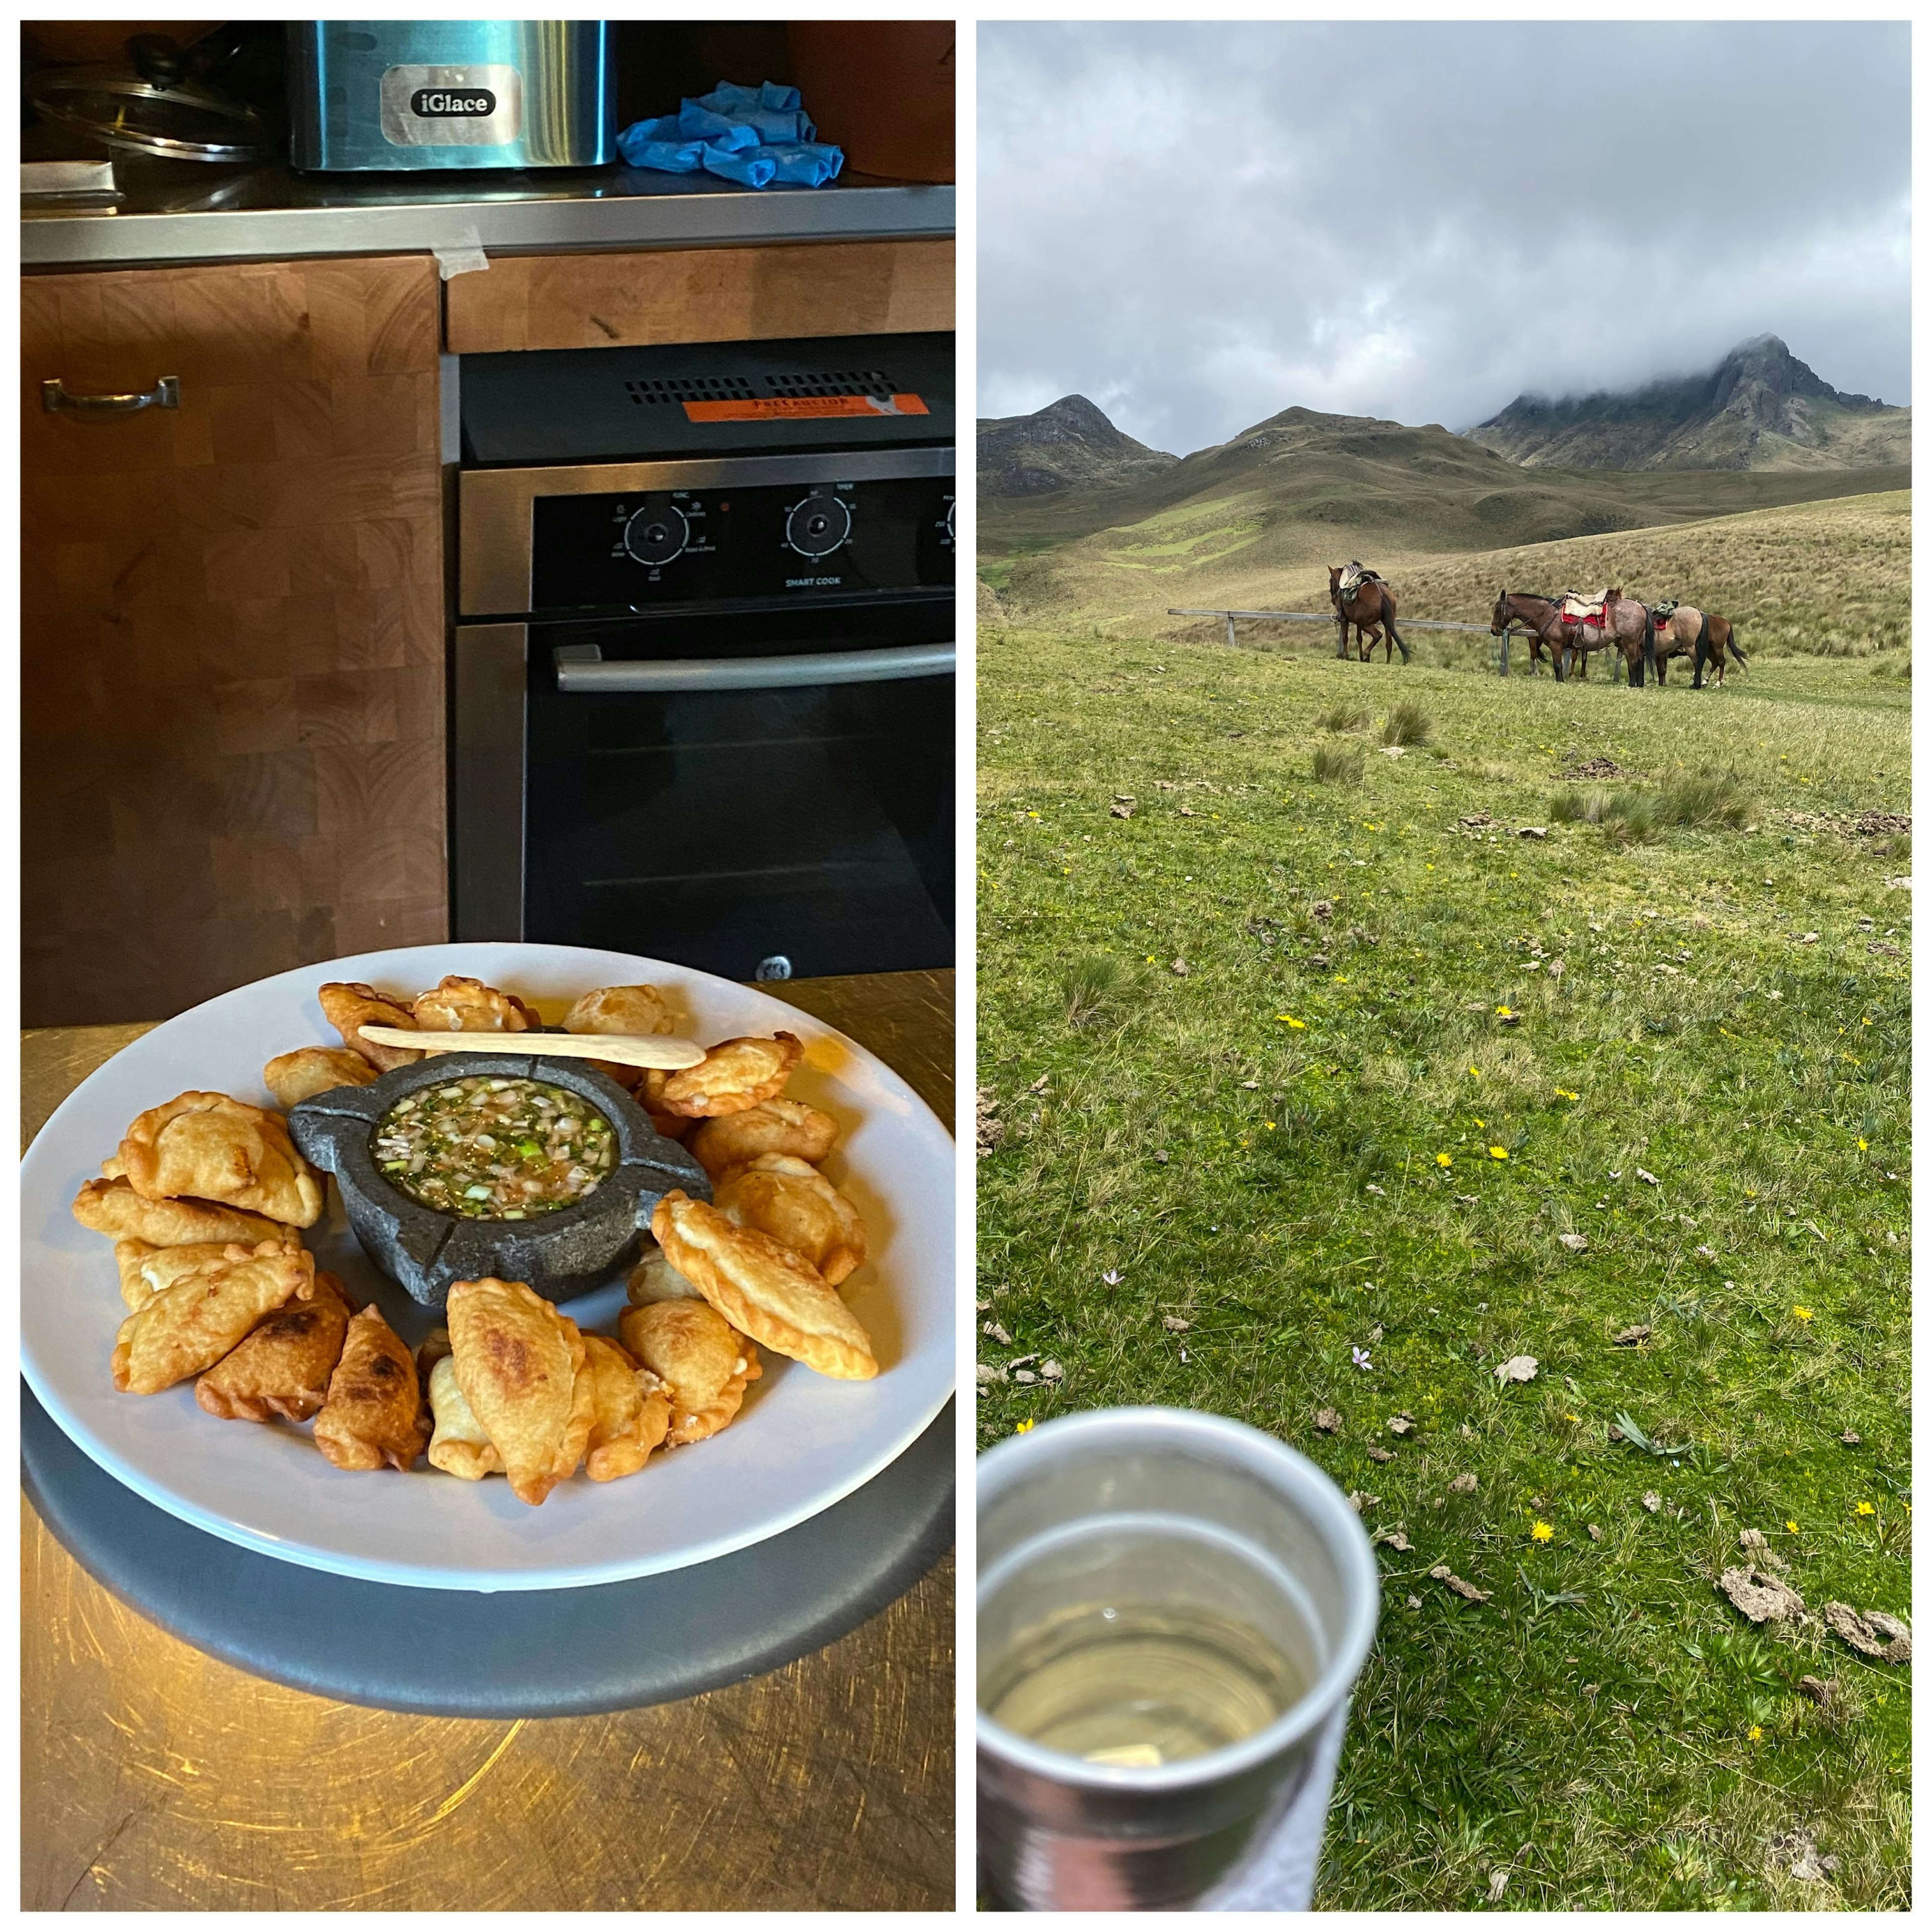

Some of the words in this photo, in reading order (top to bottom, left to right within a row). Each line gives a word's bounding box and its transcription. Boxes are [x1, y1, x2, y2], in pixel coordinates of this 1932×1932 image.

[422, 94, 488, 112] iGlace
[785, 578, 814, 587] SMART
[816, 577, 841, 586] COOK
